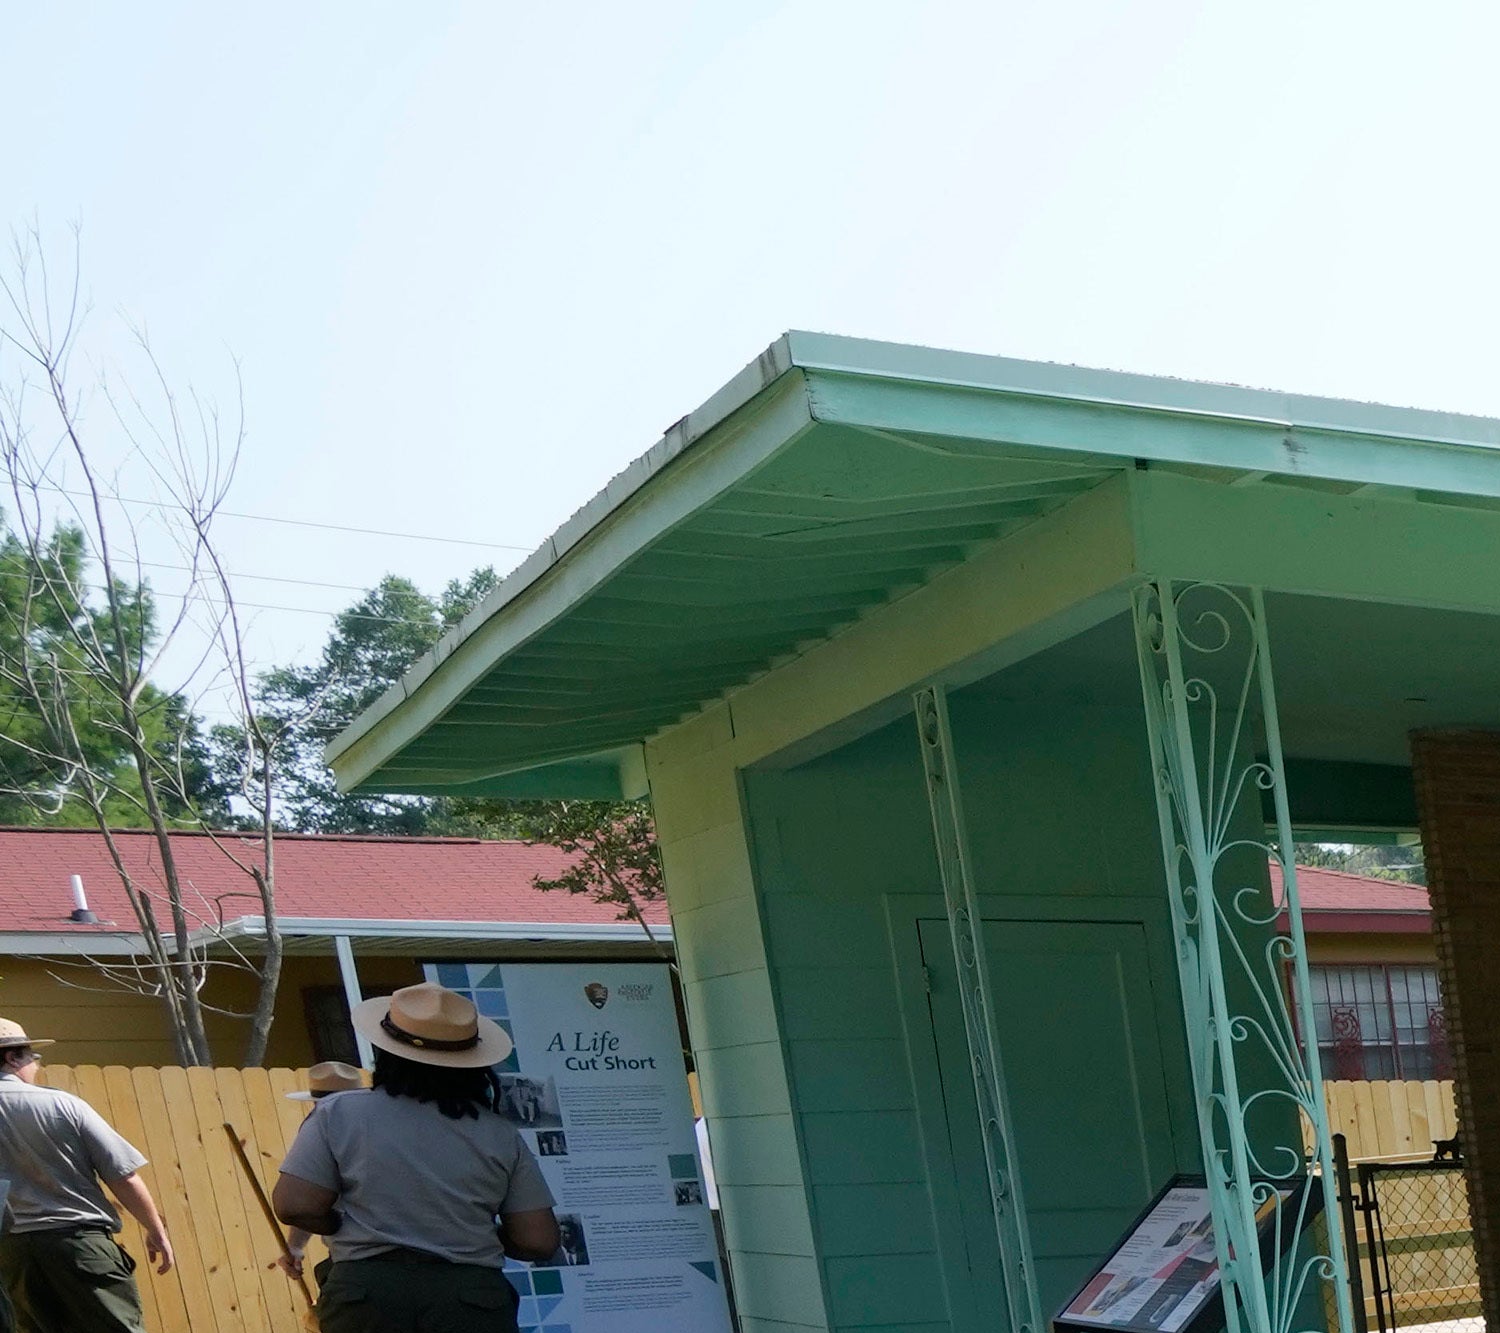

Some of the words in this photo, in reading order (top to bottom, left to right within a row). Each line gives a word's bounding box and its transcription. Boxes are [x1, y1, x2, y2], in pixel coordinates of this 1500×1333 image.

[546, 1031, 566, 1052] A
[573, 1030, 620, 1058] Life
[565, 1056, 599, 1071] Cut
[605, 1055, 657, 1071] Short
